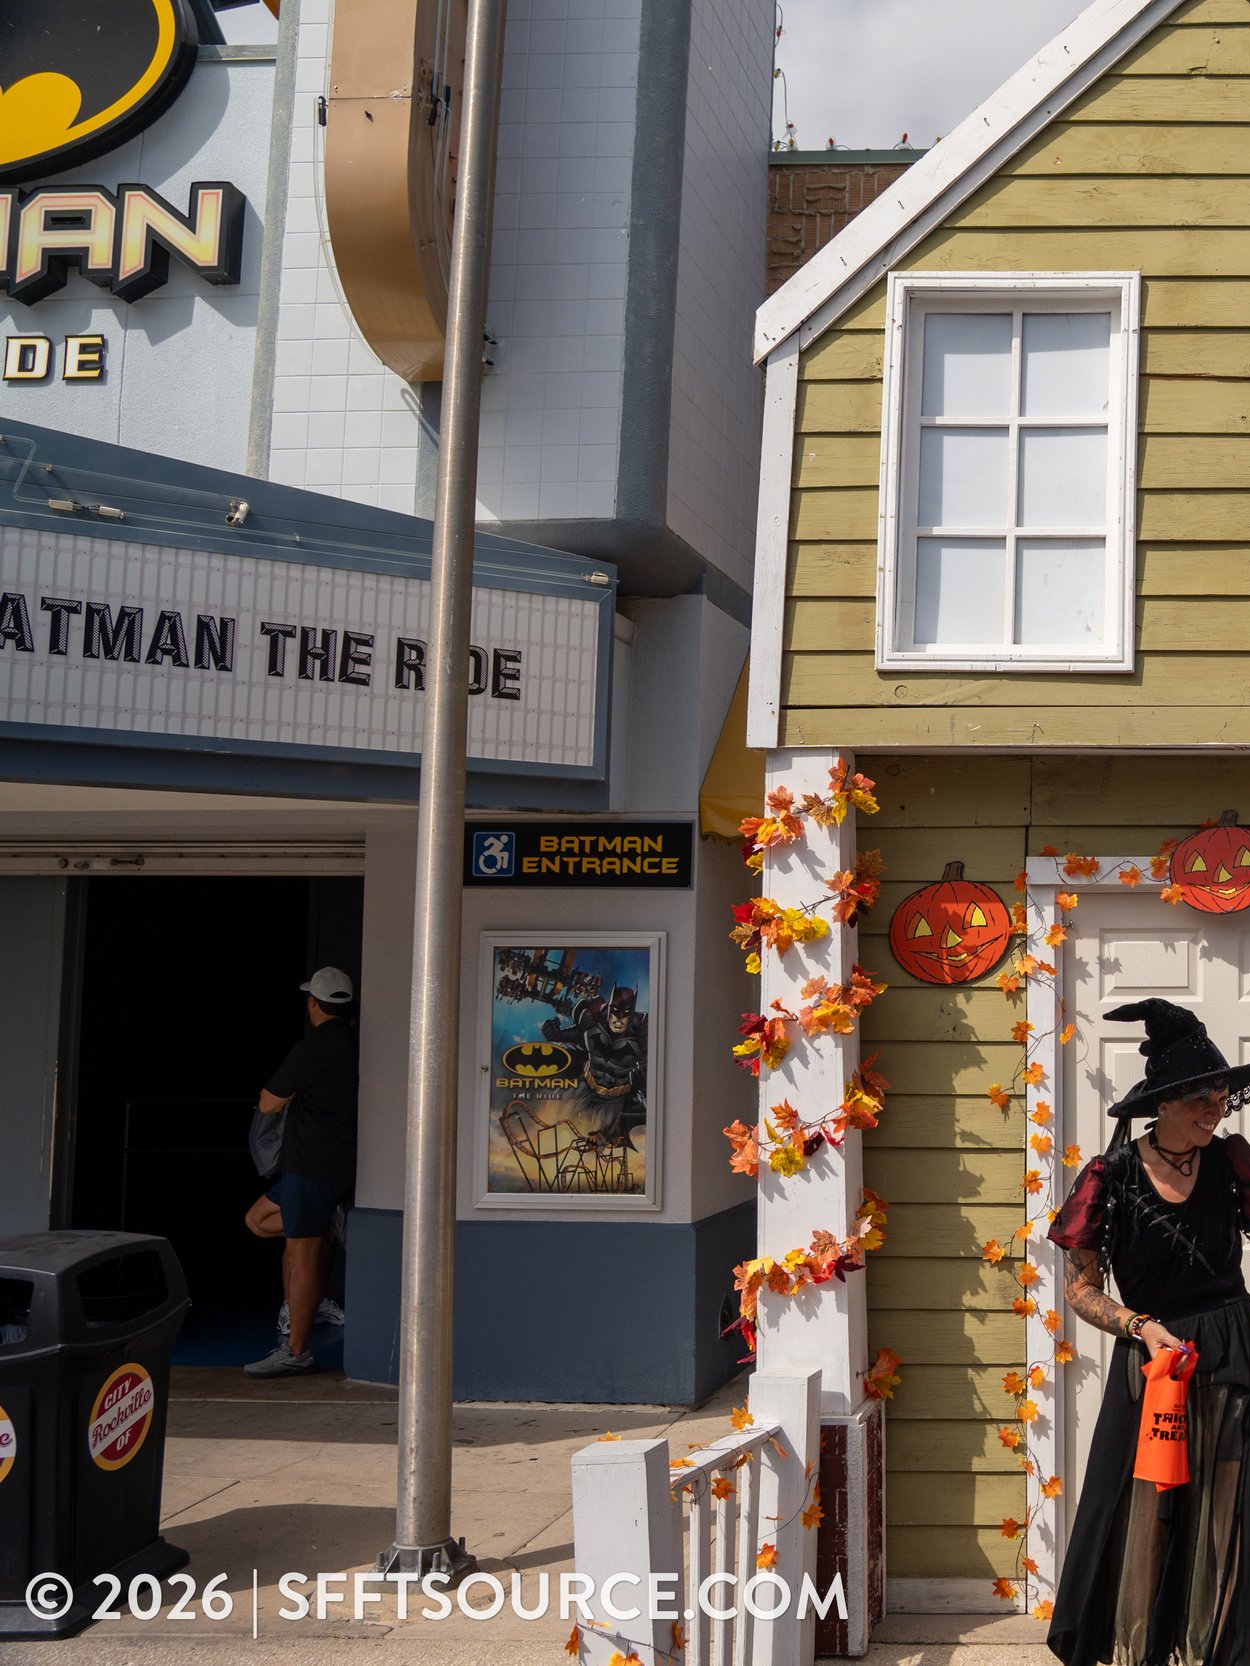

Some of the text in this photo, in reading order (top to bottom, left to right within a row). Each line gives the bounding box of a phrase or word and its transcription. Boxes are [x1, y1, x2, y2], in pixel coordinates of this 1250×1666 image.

[0, 592, 522, 700] ATMAN THE RDE
[540, 834, 663, 855] BATMAN
[522, 855, 680, 876] ENTRANCE
[495, 1077, 579, 1089] BATMAN
[104, 1377, 132, 1410] CITY
[92, 1387, 152, 1449] Rockville
[116, 1427, 132, 1451] OF
